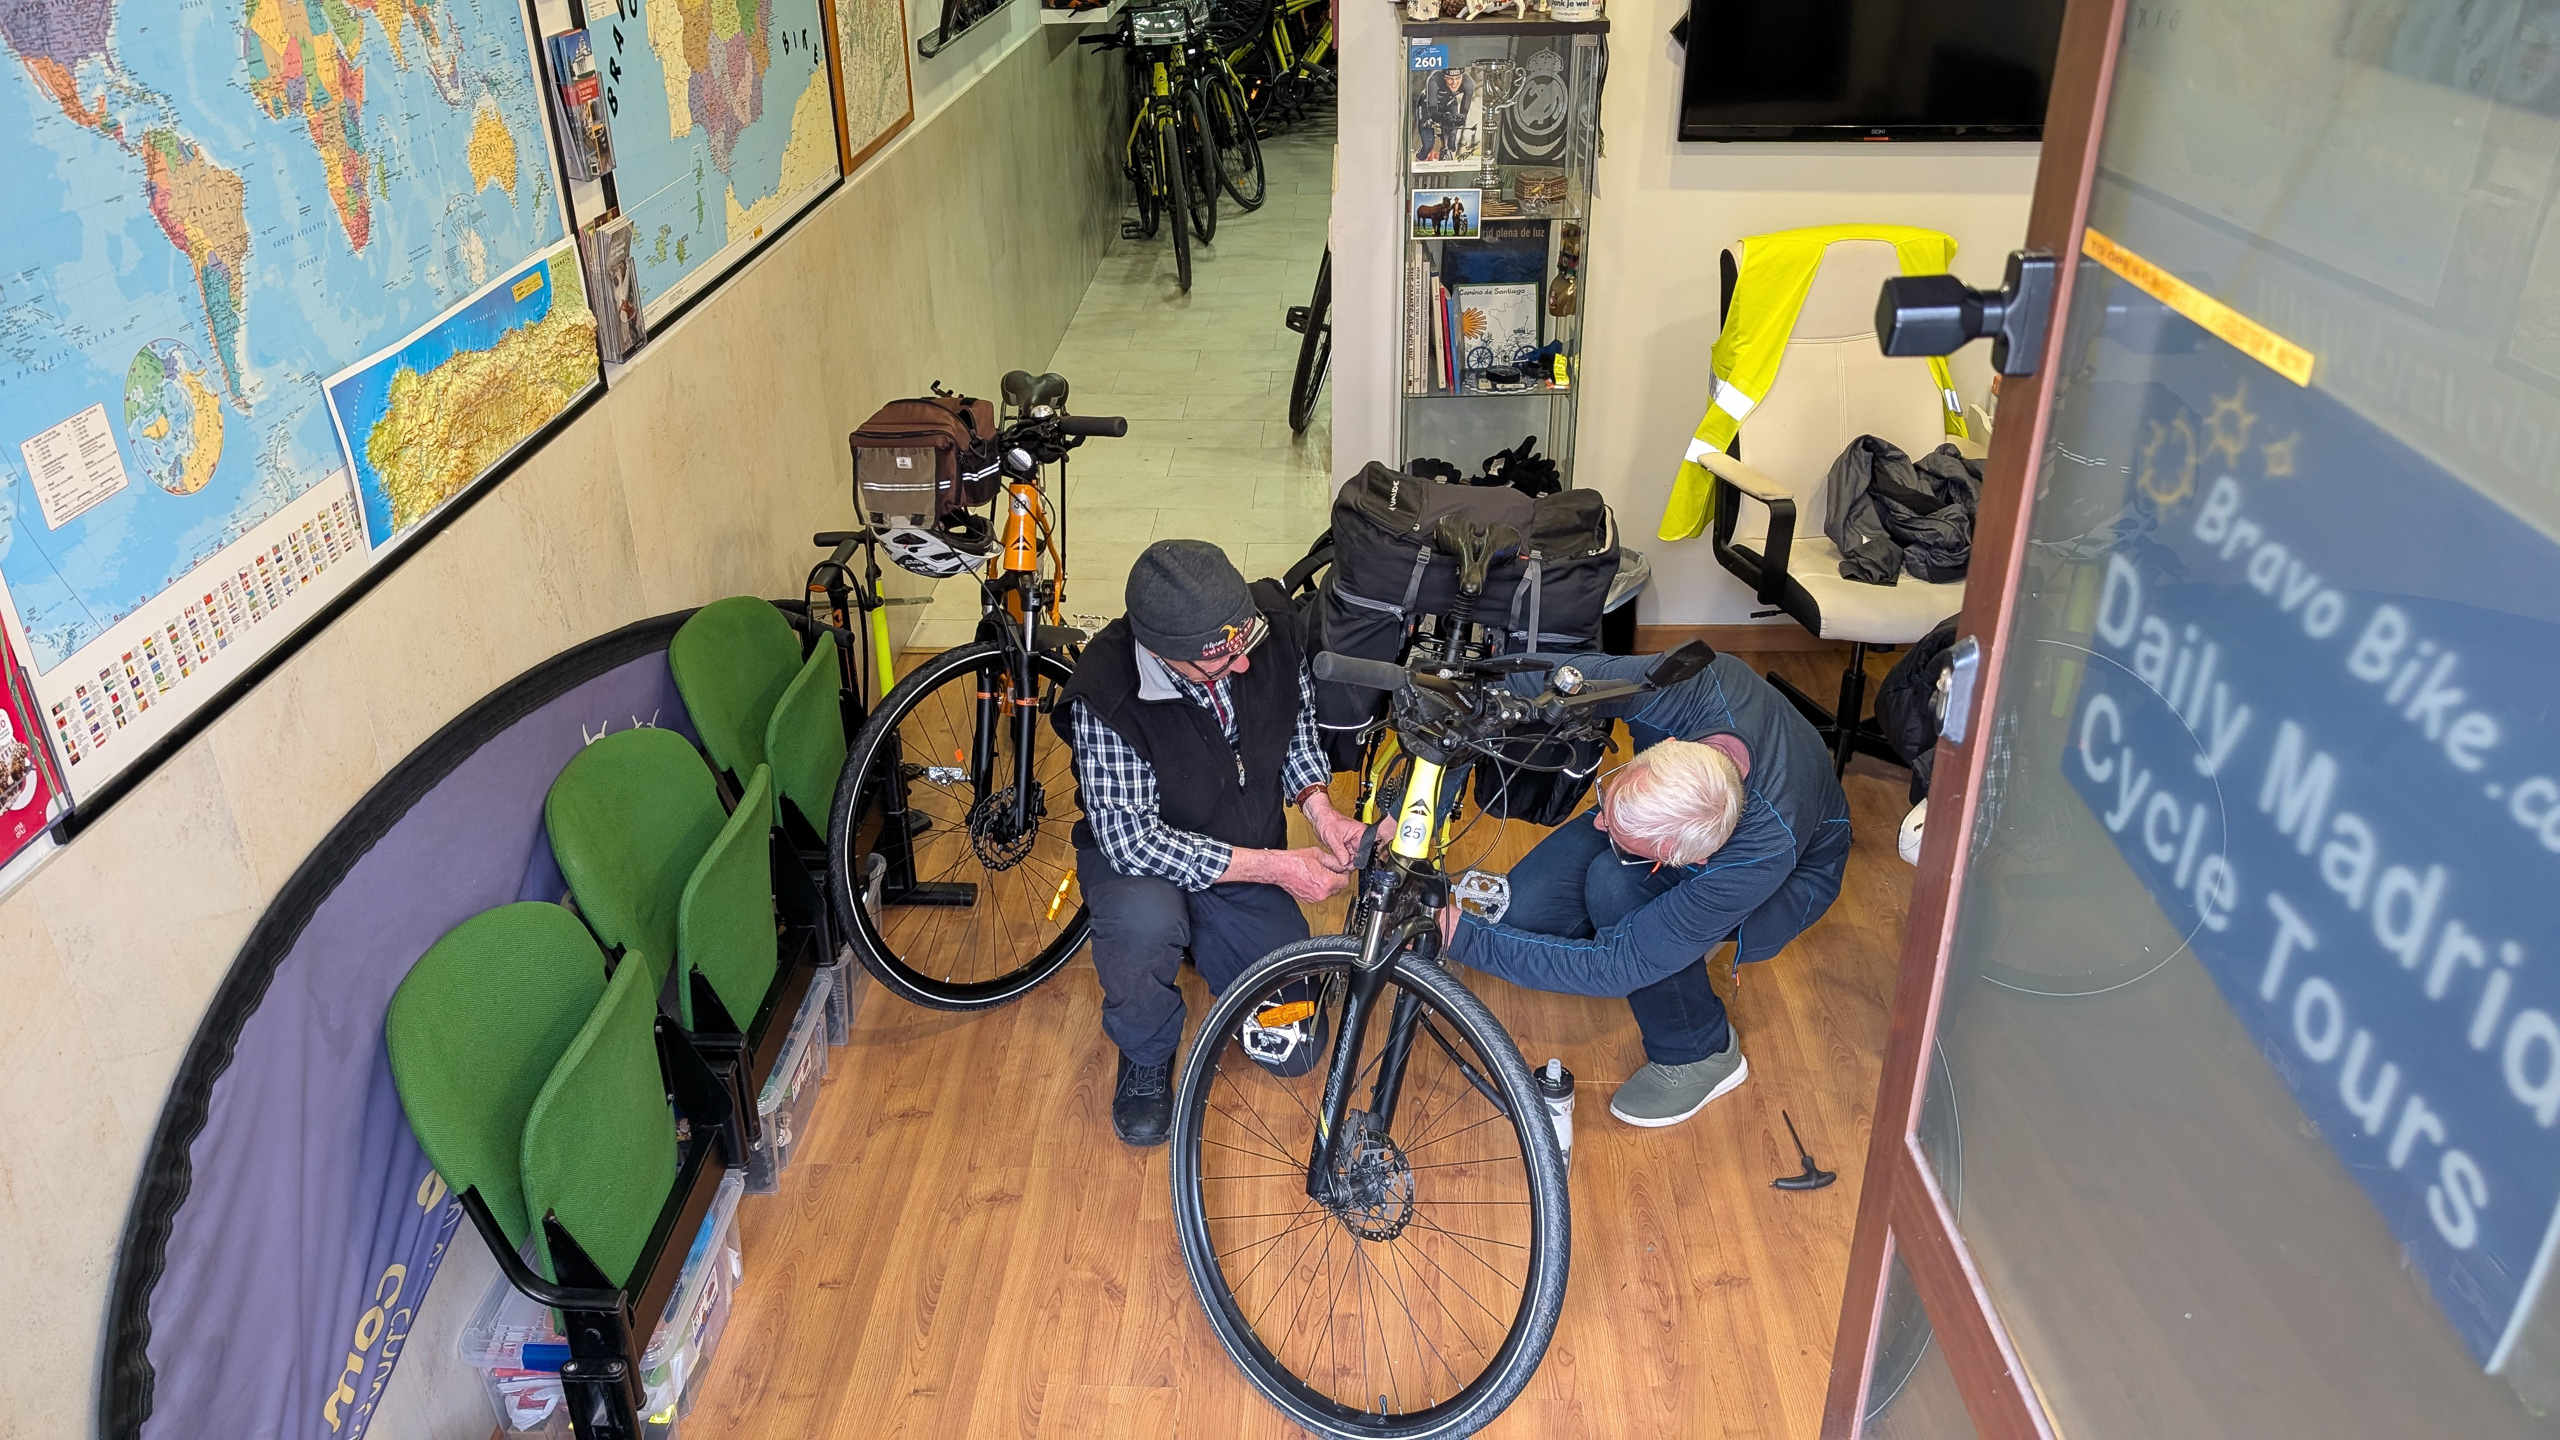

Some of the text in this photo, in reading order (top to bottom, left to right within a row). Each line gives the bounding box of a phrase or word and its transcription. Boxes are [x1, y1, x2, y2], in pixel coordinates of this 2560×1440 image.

[782, 28, 819, 66] BIKE
[1414, 56, 1443, 68] 2601
[273, 220, 328, 248] SOUTH ATLANTIC
[1496, 227, 1518, 240] plena
[1520, 227, 1531, 237] de
[1533, 227, 1545, 237] luz
[298, 256, 319, 270] OCEAN
[1459, 287, 1526, 297] Camino de Santiago
[16, 328, 116, 380] PACIFIC OCEAN
[2194, 475, 2344, 640] Bravo
[2096, 553, 2252, 778] Daily
[1403, 825, 1421, 839] 25
[2079, 694, 2489, 1250] Cycle Tours
